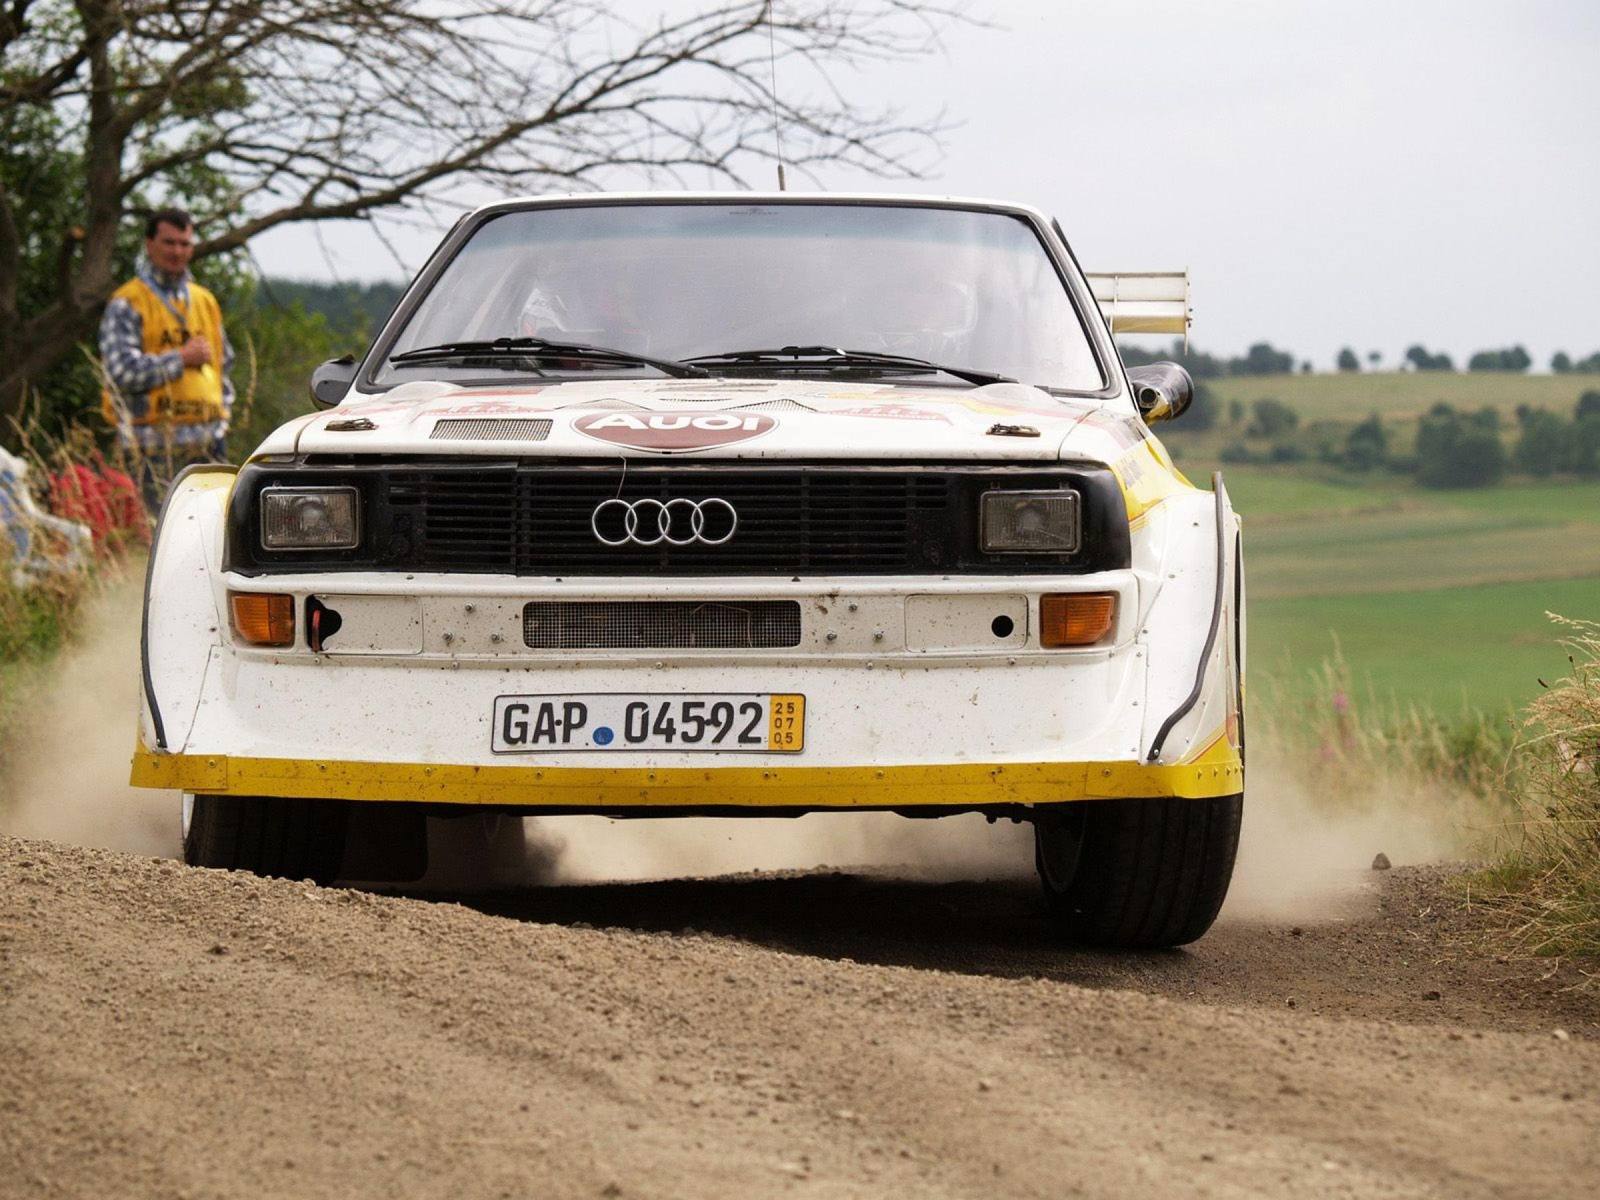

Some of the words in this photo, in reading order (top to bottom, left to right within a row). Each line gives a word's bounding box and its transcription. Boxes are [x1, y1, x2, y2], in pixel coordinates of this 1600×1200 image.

[775, 702, 795, 715] 25
[774, 717, 794, 729] 07
[774, 731, 793, 744] 05
